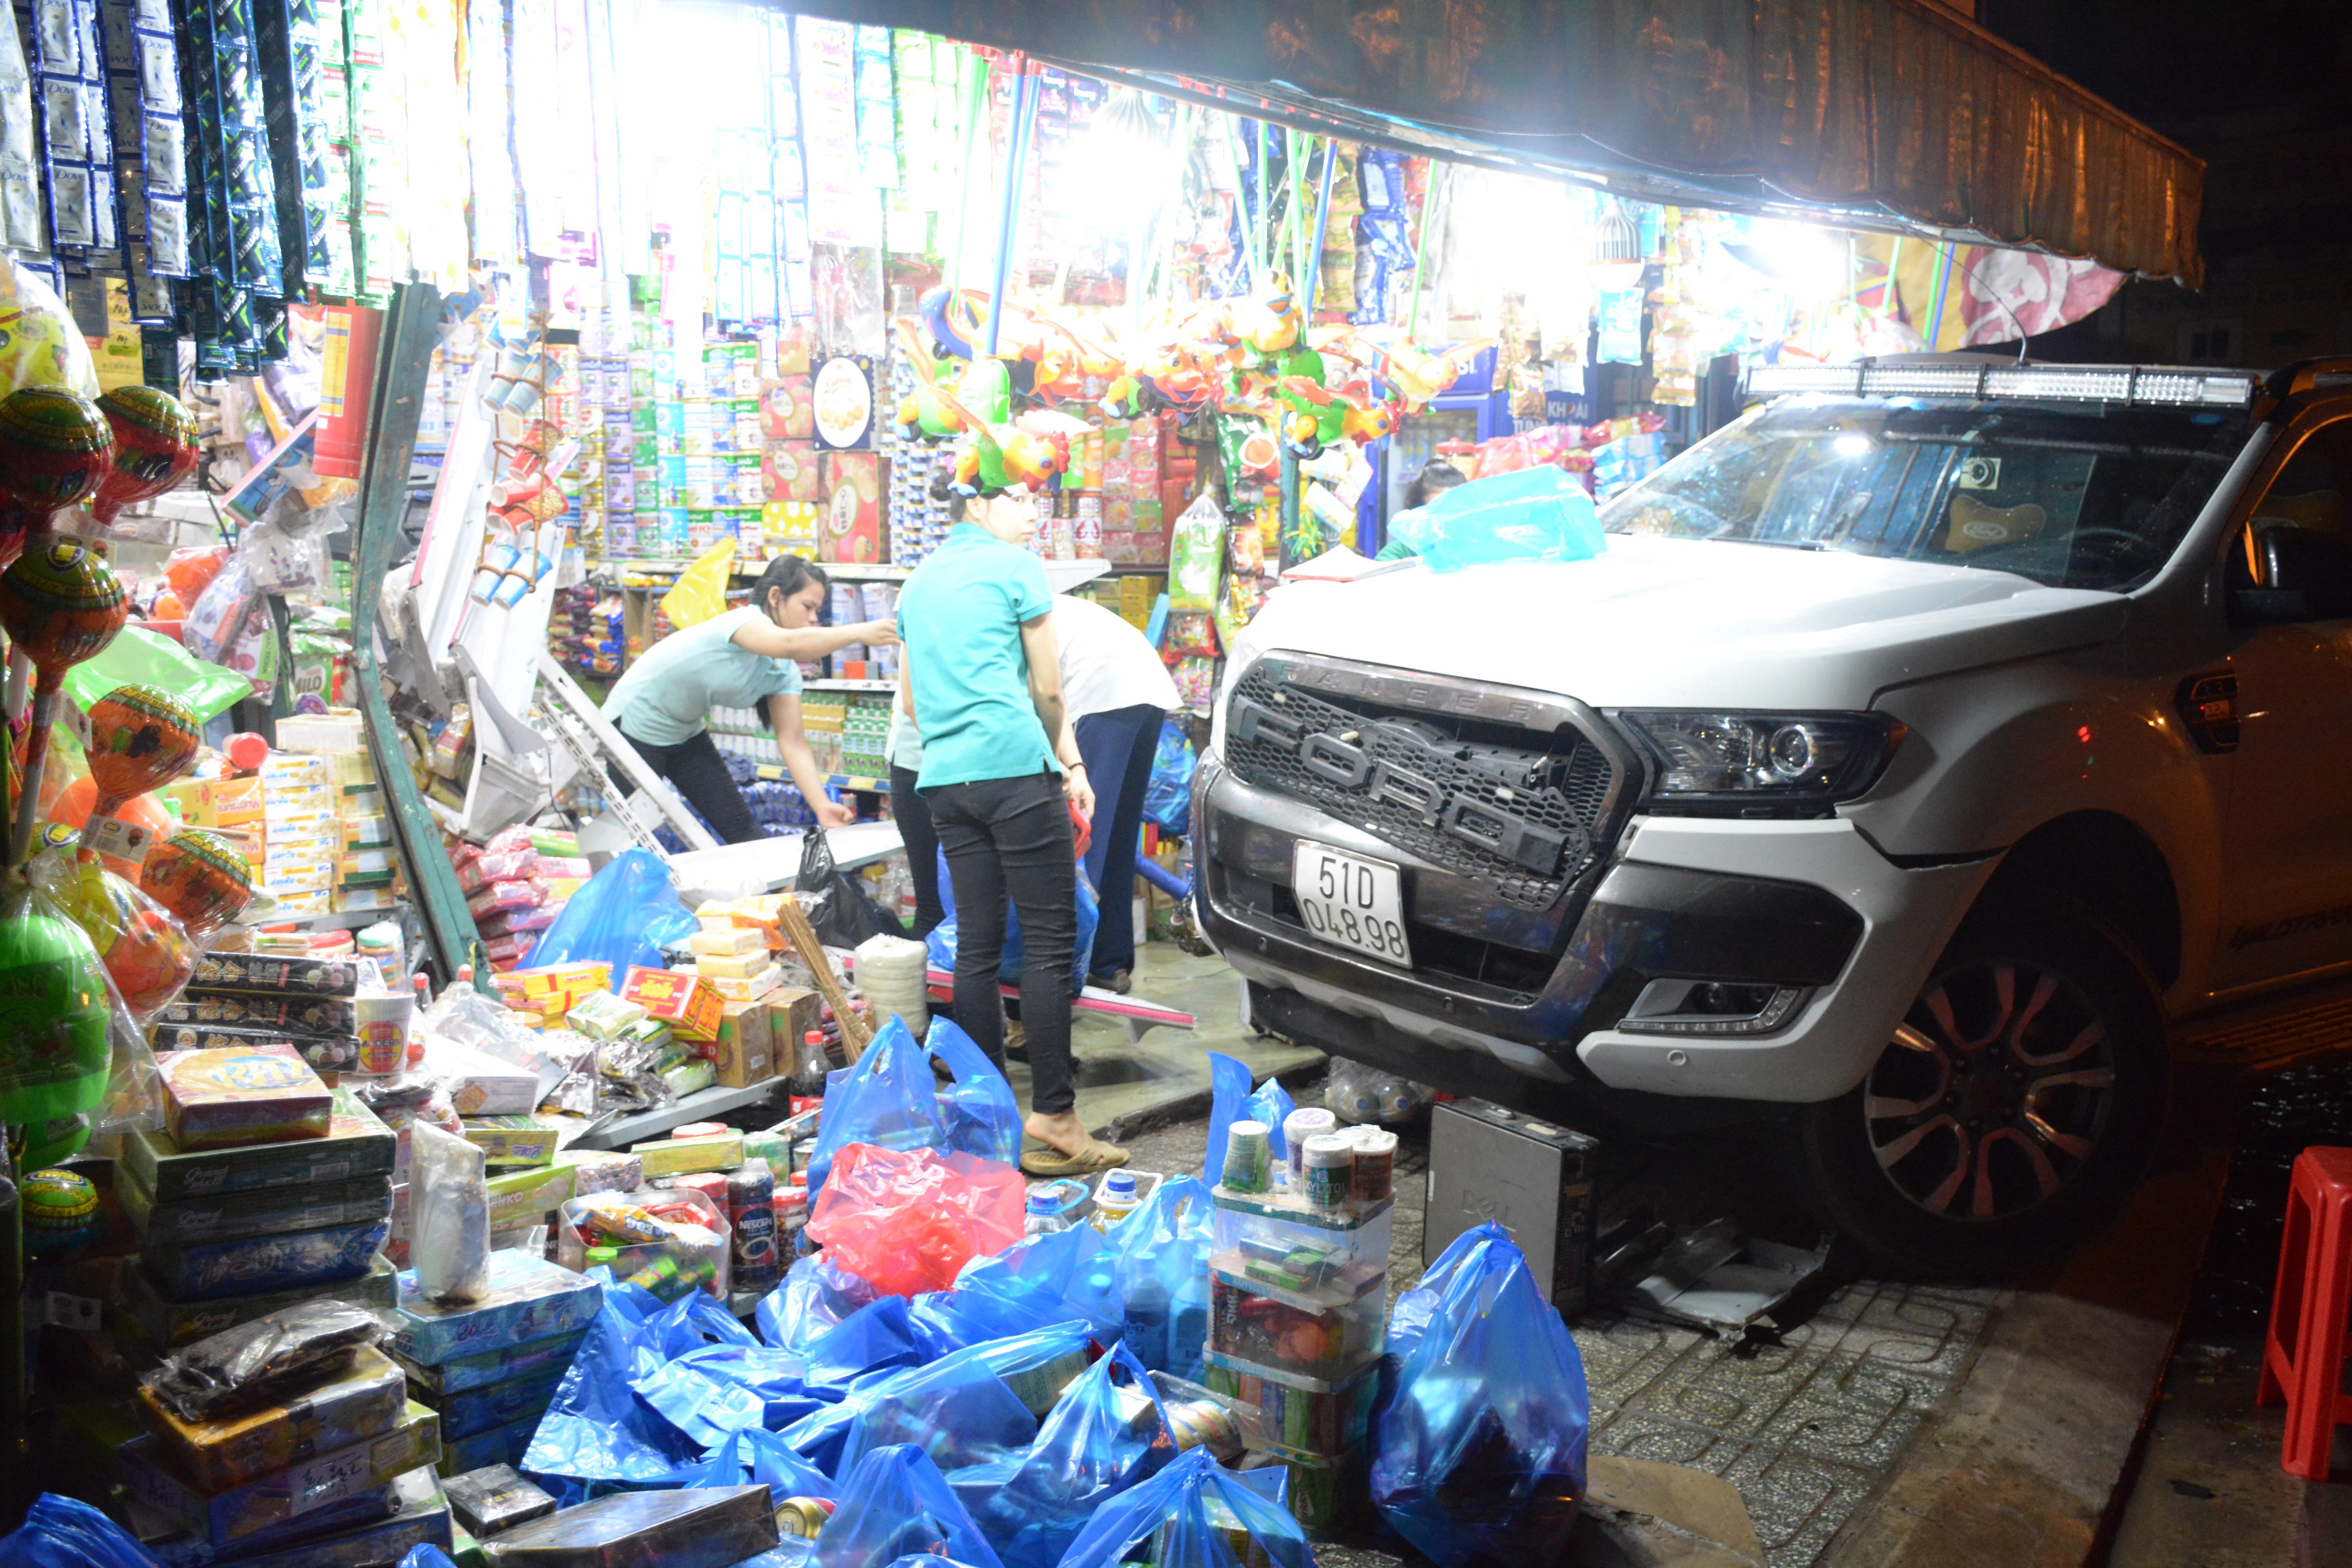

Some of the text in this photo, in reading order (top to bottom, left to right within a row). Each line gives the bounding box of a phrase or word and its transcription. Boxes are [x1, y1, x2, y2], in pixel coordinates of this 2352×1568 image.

[143, 38, 169, 50] Dove
[48, 81, 78, 94] Dove
[150, 119, 176, 132] Dove
[1, 169, 30, 182] Dove
[56, 168, 85, 181] Dove
[153, 201, 181, 213] Dove
[141, 303, 169, 312] Dove
[1279, 664, 1531, 719] RANGER
[1239, 698, 1526, 859] FORD
[1319, 855, 1374, 910] 51D
[1301, 897, 1405, 960] 048.98
[219, 1059, 315, 1089] RITZ
